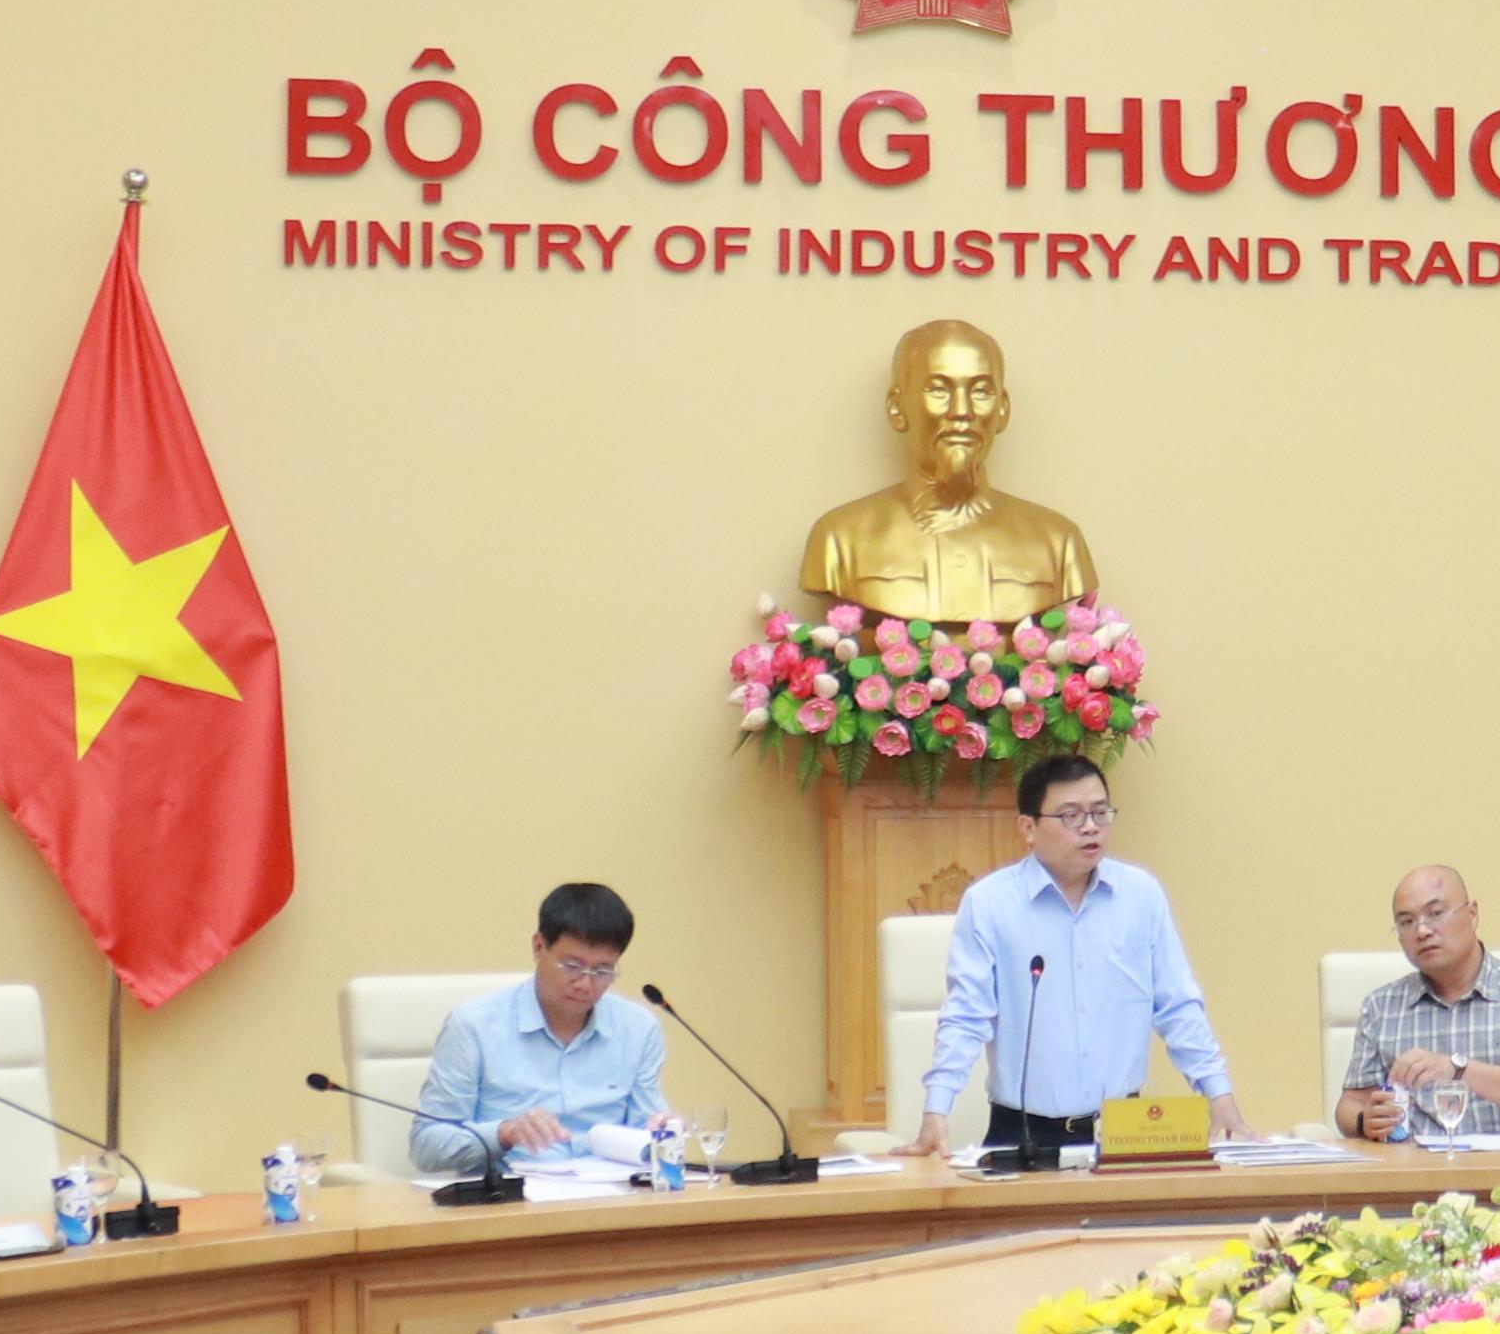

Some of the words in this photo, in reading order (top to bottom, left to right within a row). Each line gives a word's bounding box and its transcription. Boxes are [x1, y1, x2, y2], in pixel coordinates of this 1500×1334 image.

[285, 48, 482, 202] BỘ
[532, 55, 931, 186] CÔNG
[283, 218, 630, 271] MINISTRY
[654, 225, 751, 273] OF
[778, 228, 1137, 280] INDUSTRY
[1153, 235, 1302, 283] AND
